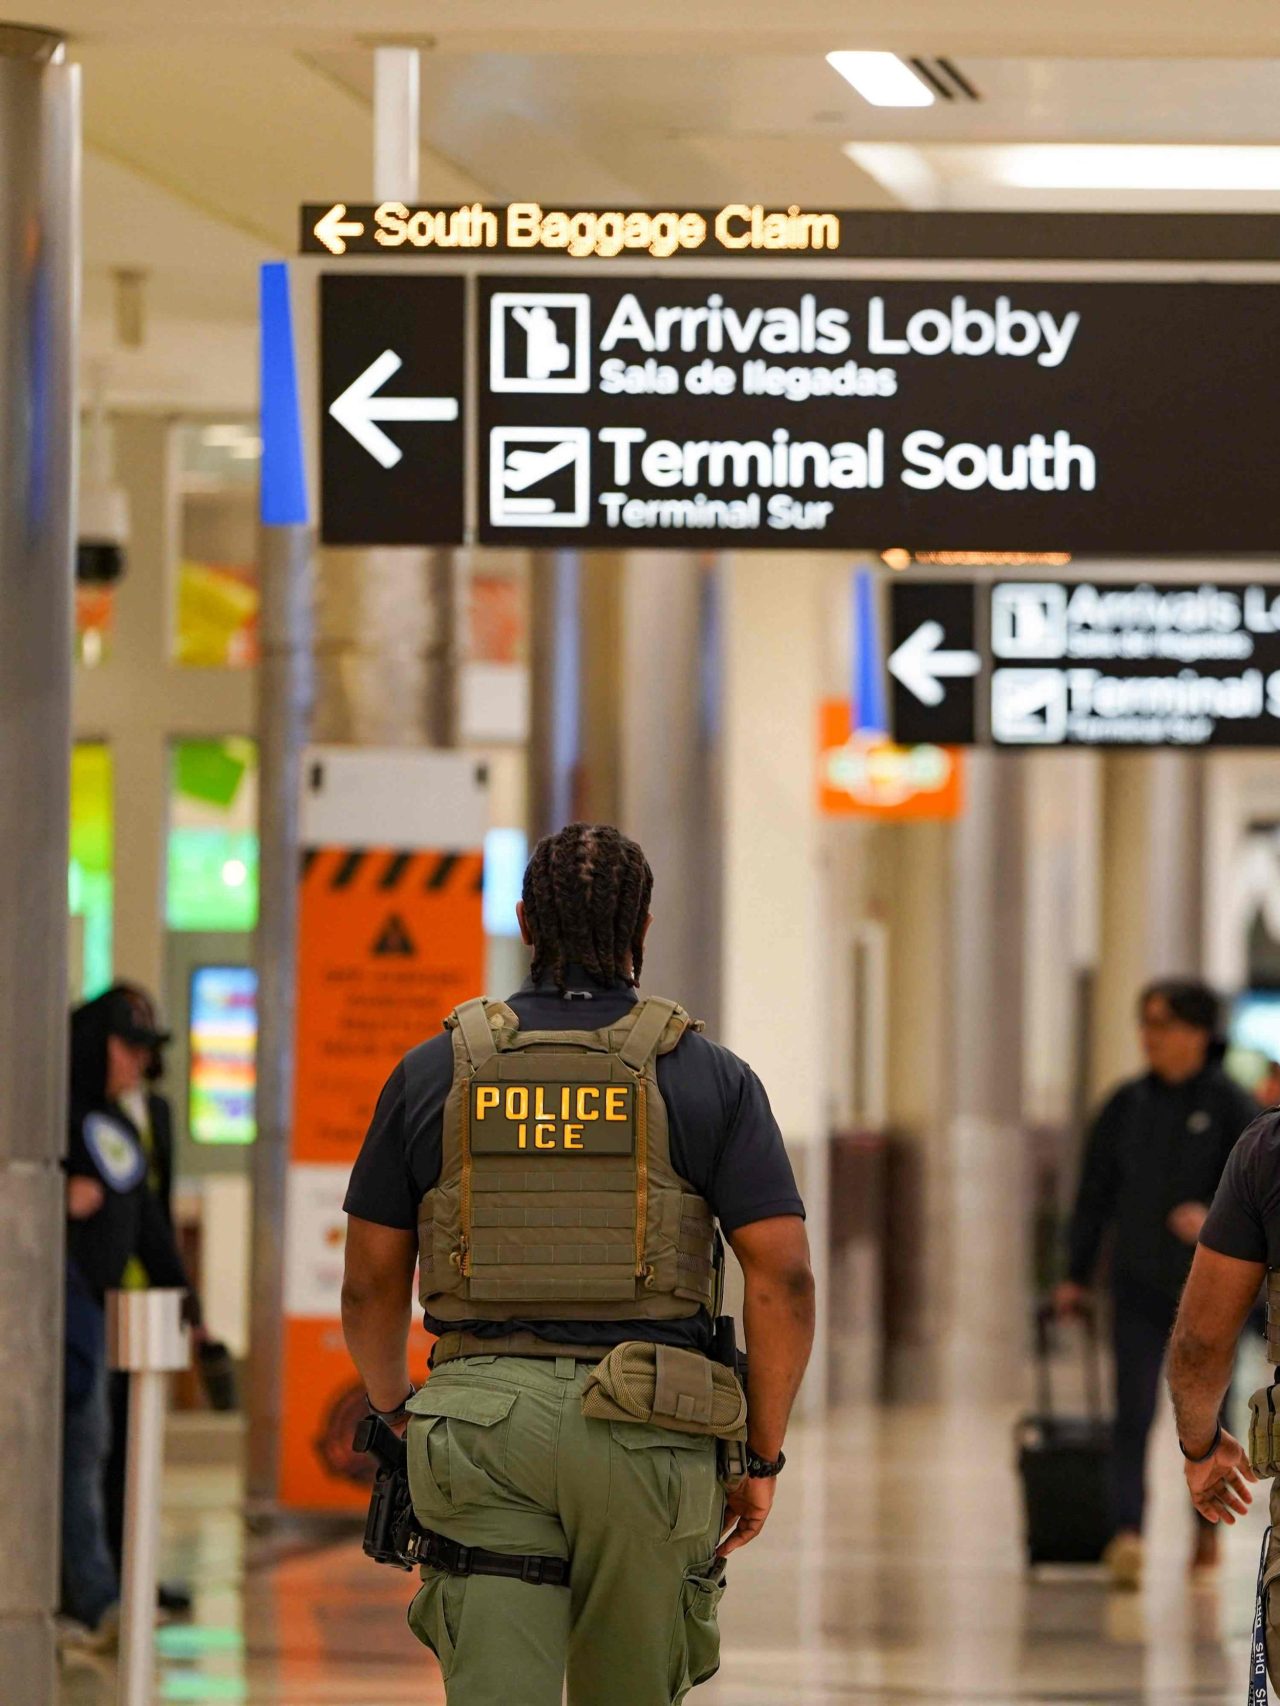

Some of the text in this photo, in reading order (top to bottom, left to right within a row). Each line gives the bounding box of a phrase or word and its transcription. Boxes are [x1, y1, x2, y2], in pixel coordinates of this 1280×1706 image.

[374, 202, 840, 257] South Baggage Claim
[600, 294, 1080, 367] Arrivals Lobby
[600, 358, 898, 401] Sala de llegadas
[599, 428, 1096, 492] Terminal South
[599, 493, 834, 531] Terminal Sur
[475, 1086, 629, 1121] POLICE
[517, 1123, 586, 1149] ICE
[1255, 1642, 1265, 1674] DHS
